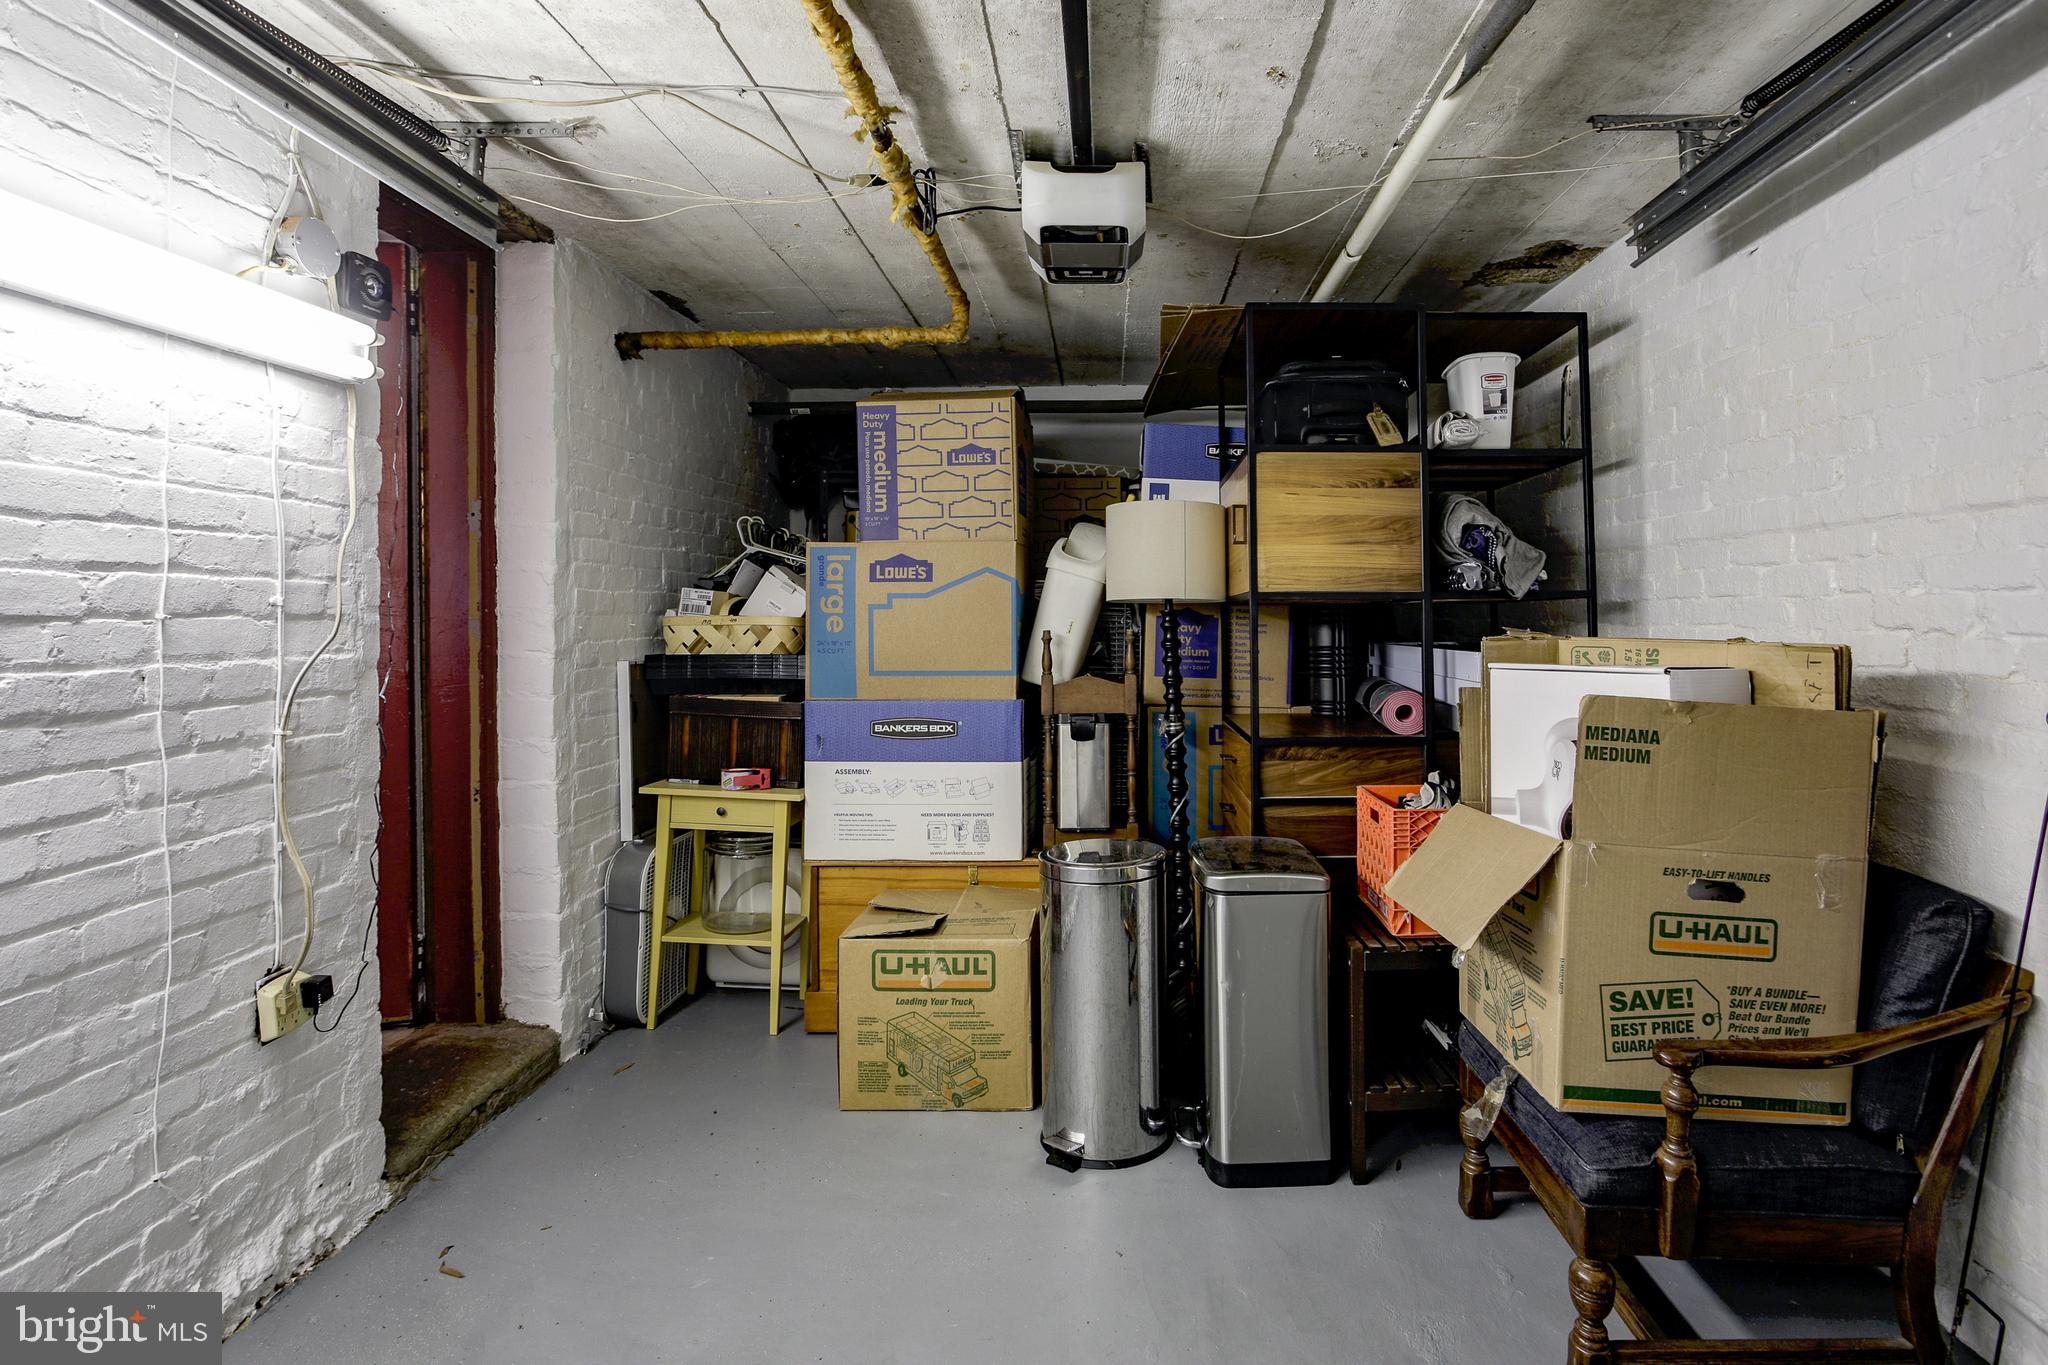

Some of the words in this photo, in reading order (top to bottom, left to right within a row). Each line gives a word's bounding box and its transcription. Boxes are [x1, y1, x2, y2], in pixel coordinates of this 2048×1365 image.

[862, 412, 890, 421] Heavy
[862, 421, 883, 429] Duty
[952, 452, 992, 464] LOWE'S
[873, 431, 892, 513] medium
[876, 564, 927, 579] LOWE'S
[820, 554, 851, 633] large
[1178, 625, 1202, 635] avy
[1178, 646, 1209, 657] dium
[874, 724, 928, 733] BANKERS
[929, 724, 955, 733] BOX
[1586, 725, 1661, 745] MEDIANA
[1584, 745, 1652, 764] MEDIUM
[1663, 867, 1726, 880] EASY-TO-LIFT
[1727, 871, 1771, 883] HANDLES
[1659, 919, 1769, 945] U-HAUL
[880, 956, 988, 976] U-HAUL
[1754, 987, 1762, 998] A
[896, 997, 928, 1007] Loading
[930, 997, 949, 1006] Your
[951, 997, 973, 1006] Truck
[1609, 988, 1694, 1013] SAVE!
[1729, 998, 1757, 1010] SAVE
[1760, 1000, 1787, 1012] EVEN
[1790, 1003, 1827, 1015] MORE!
[1728, 1011, 1752, 1021] Beat
[1754, 1013, 1773, 1023] Our
[1775, 1014, 1811, 1025] Bundle
[1611, 1022, 1647, 1037] BEST
[1651, 1020, 1694, 1035] PRICE
[1727, 1023, 1759, 1034] Prices
[1762, 1026, 1781, 1036] and
[1784, 1026, 1810, 1037] We'll
